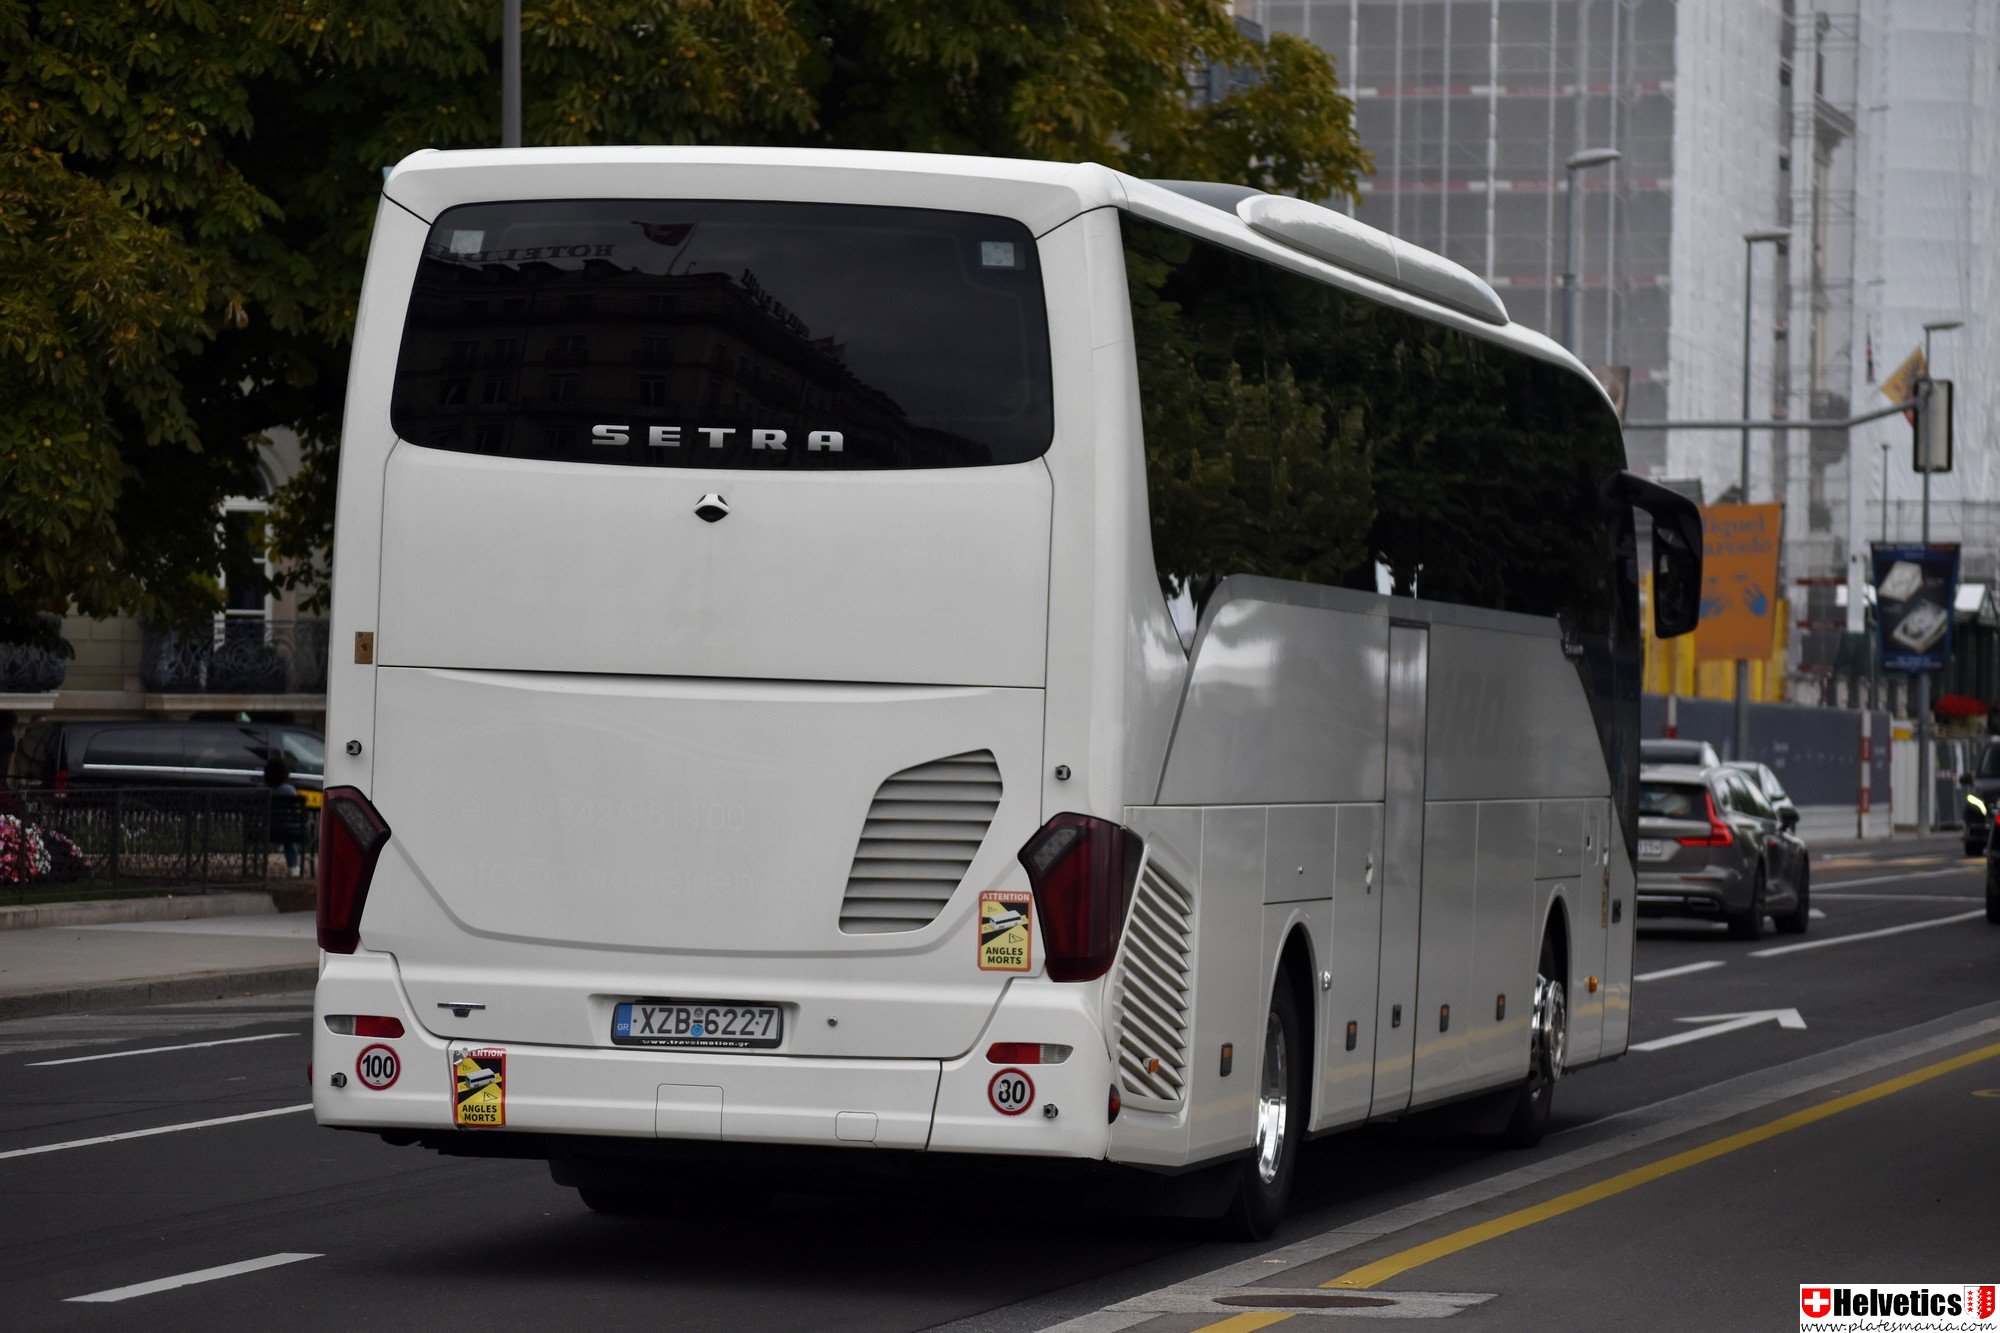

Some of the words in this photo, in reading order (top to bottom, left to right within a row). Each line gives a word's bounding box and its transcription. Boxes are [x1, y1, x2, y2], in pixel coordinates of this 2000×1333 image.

[591, 424, 844, 452] SETRA
[982, 893, 1030, 901] ATTENTION
[985, 946, 1023, 956] ANGLES
[987, 955, 1022, 965] MORTS
[617, 1023, 630, 1031] GR
[362, 1054, 395, 1079] 100
[461, 1104, 498, 1113] ANGLES
[463, 1113, 496, 1122] MORTS
